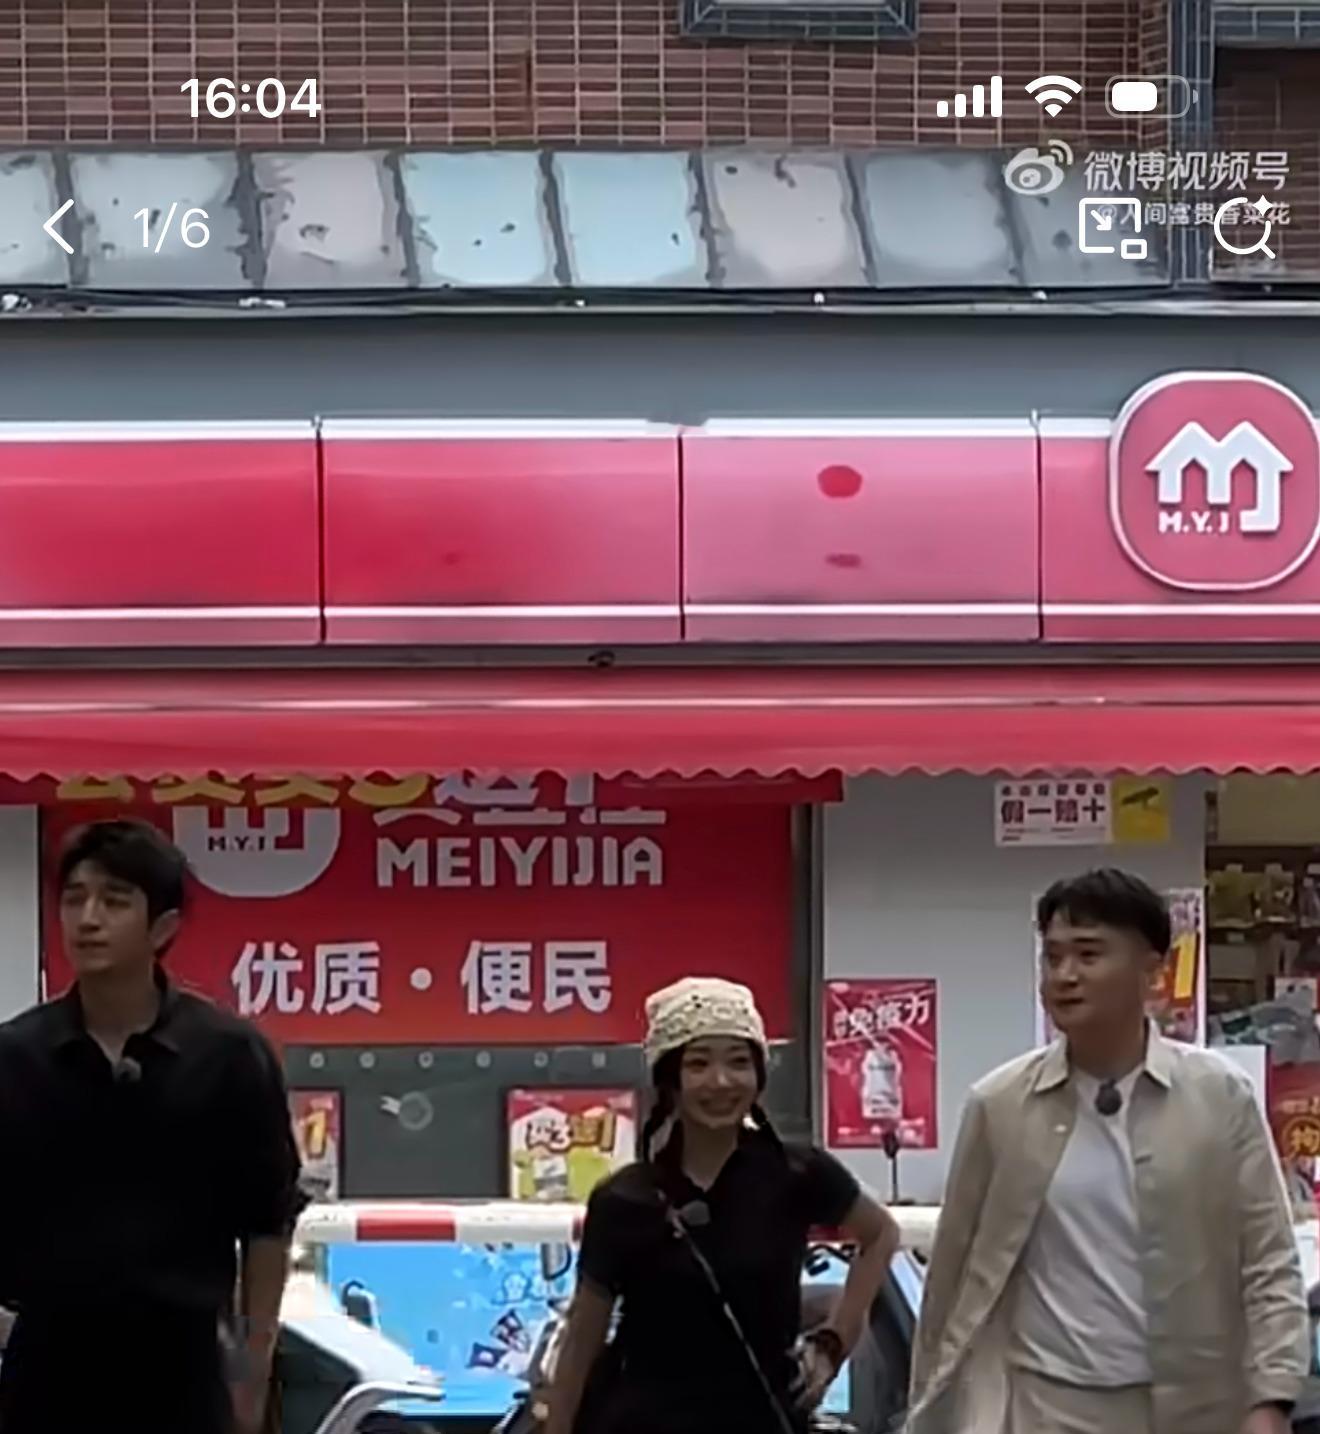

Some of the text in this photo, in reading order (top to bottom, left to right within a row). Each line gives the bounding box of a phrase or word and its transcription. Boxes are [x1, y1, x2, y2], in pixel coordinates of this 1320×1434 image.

[1158, 510, 1229, 533] M.Y.J
[376, 837, 663, 887] MEIYIJIA
[231, 939, 612, 1015] 优质·便民
